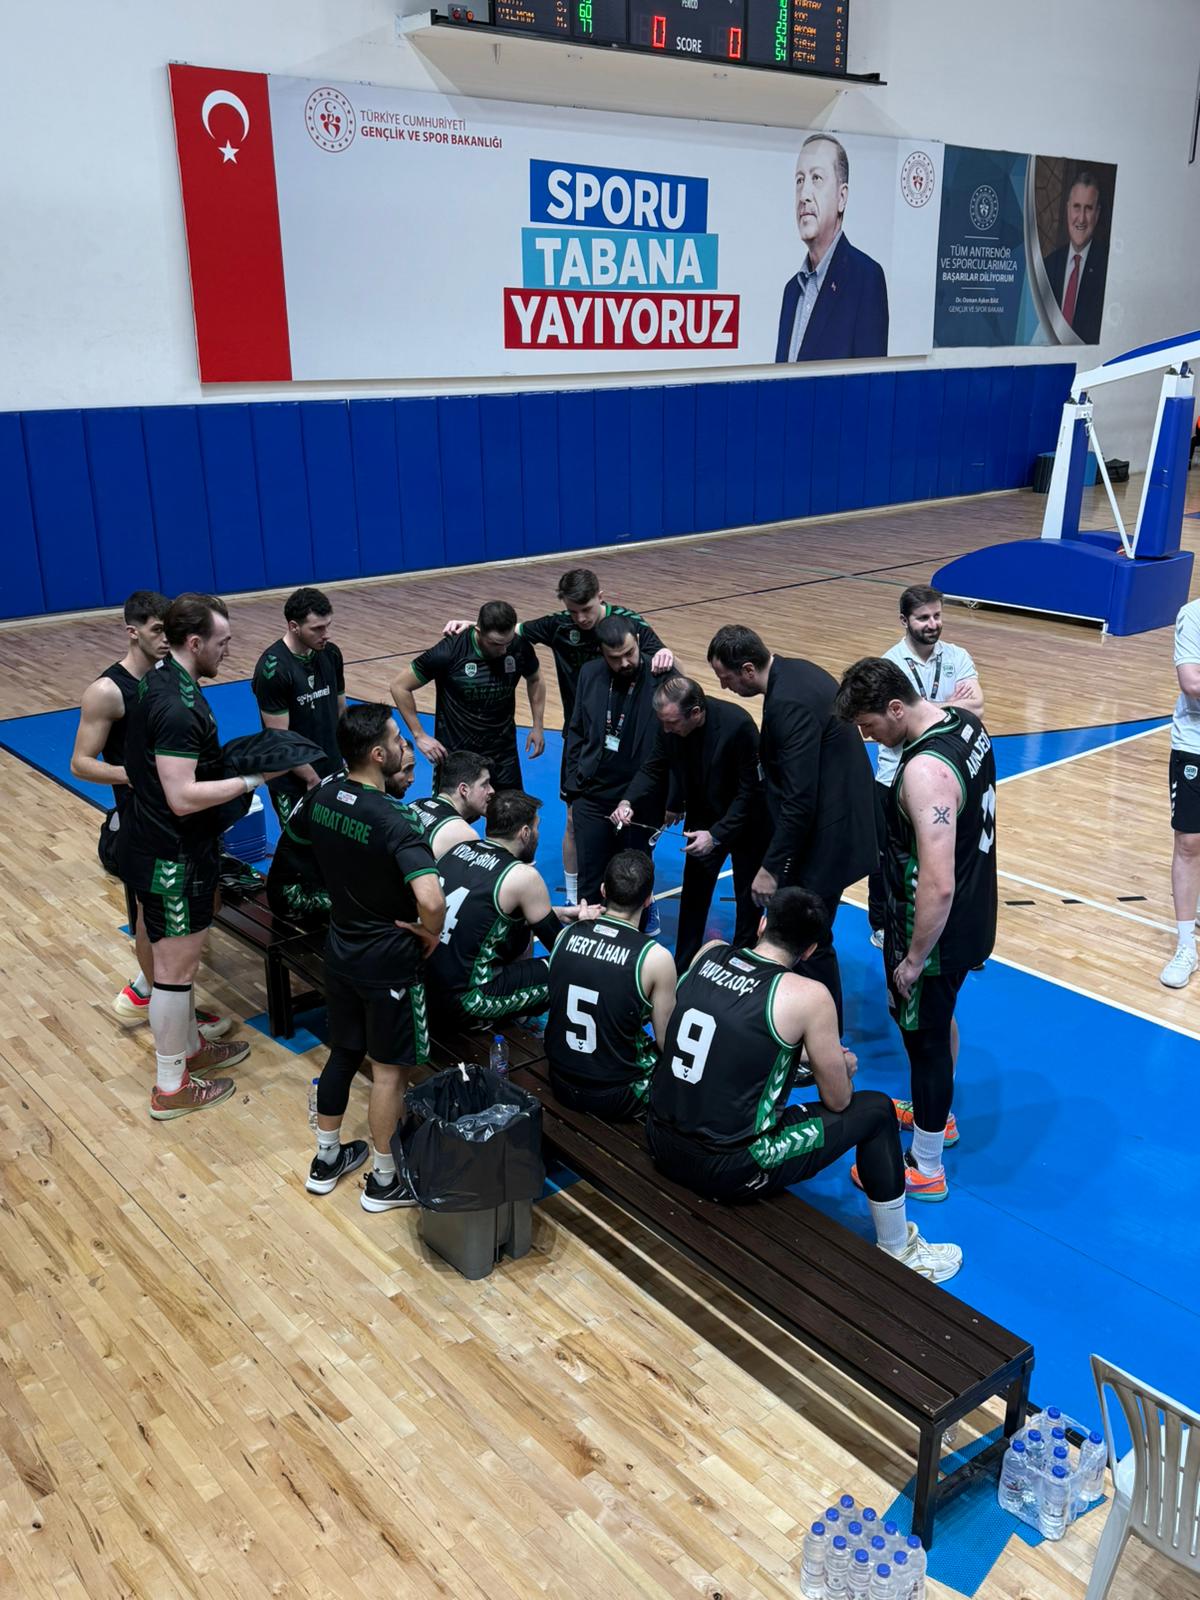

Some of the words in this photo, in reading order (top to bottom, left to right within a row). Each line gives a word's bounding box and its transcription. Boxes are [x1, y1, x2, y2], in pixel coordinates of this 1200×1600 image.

[579, 3, 592, 18] 60
[580, 18, 593, 33] 77
[653, 16, 666, 48] 0
[676, 36, 702, 53] SCORE
[729, 27, 742, 58] 0
[360, 109, 400, 125] TÜRKİYE
[403, 114, 466, 131] CUMHURİYETİ
[361, 125, 405, 142] GENÇLİK
[408, 130, 420, 141] VE
[423, 131, 449, 144] SPOR
[451, 134, 502, 148] BAKANLIĞI
[546, 169, 687, 230] SPORU
[535, 237, 704, 286] TABANA
[940, 258, 951, 269] VE
[951, 258, 1018, 271] SPORCULARIMIZA
[950, 244, 968, 257] TÜM
[969, 245, 1011, 259] ANTRENÖR
[942, 272, 978, 283] BAŞARILAR
[980, 271, 1015, 282] DİLİYORUM
[510, 295, 734, 344] YAYIYORUZ
[312, 802, 343, 831] MURAT
[341, 816, 372, 845] DERE
[565, 935, 597, 956] MERT
[593, 939, 630, 966] İLHAN
[566, 984, 599, 1053] 5
[671, 1007, 716, 1085] 9
